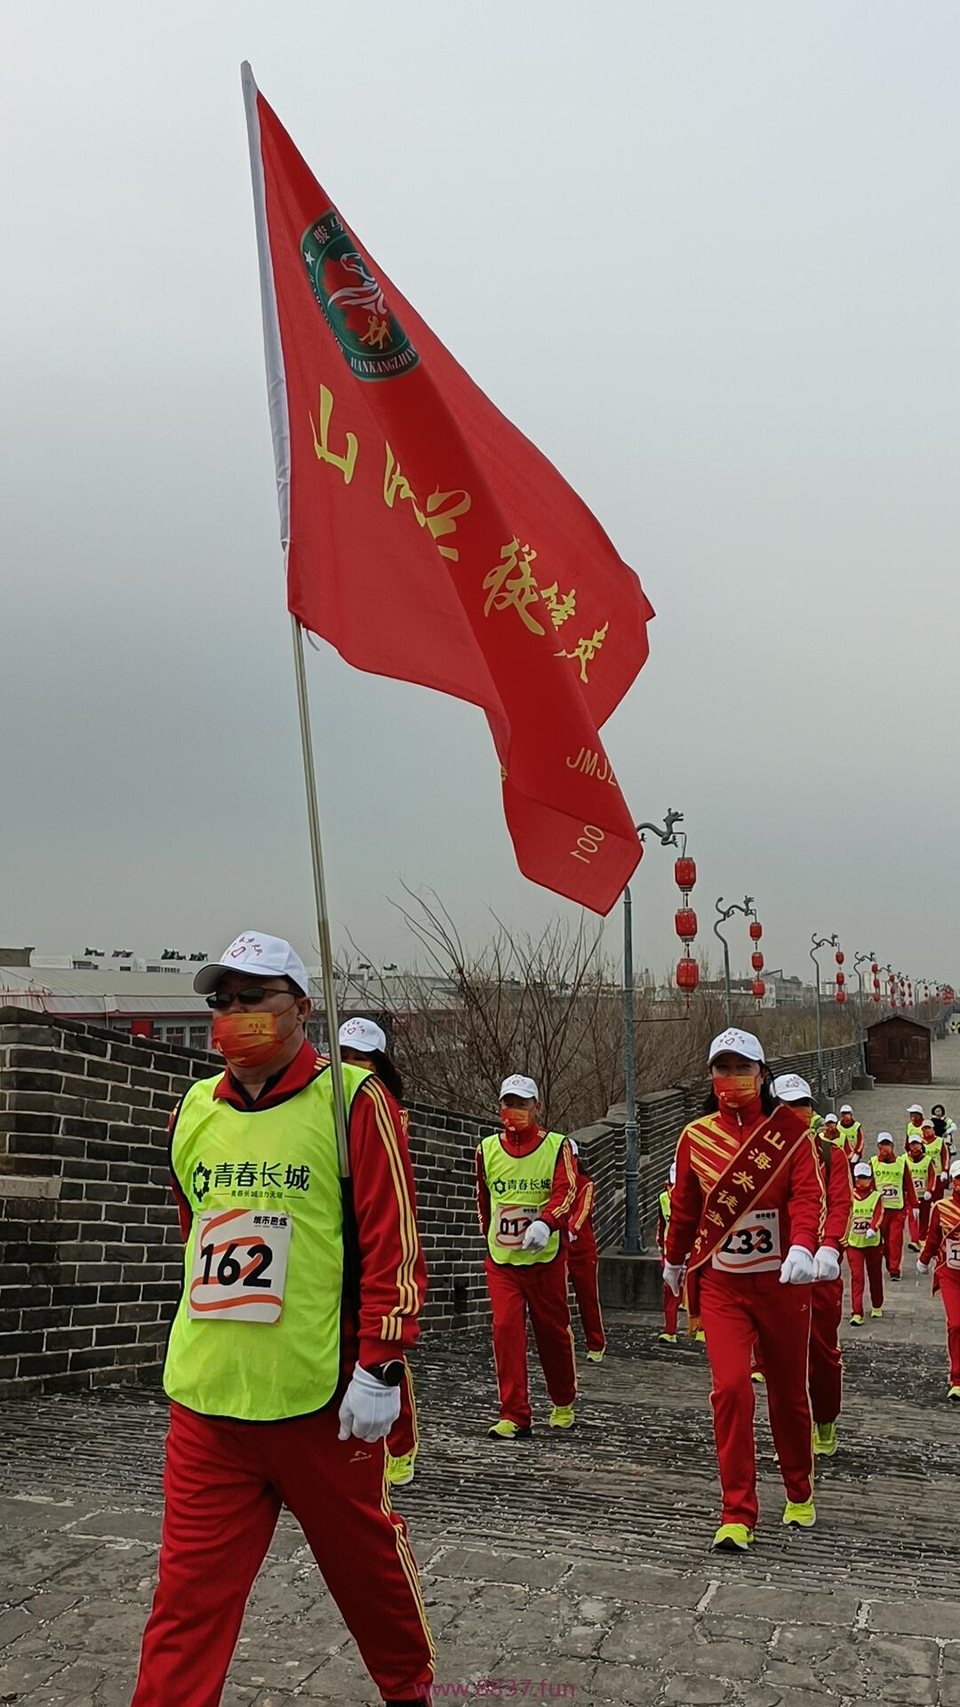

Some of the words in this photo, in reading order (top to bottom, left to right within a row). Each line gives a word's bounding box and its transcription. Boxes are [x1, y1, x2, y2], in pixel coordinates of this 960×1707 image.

[214, 1161, 311, 1192] 青春长城
[200, 1243, 274, 1288] 162
